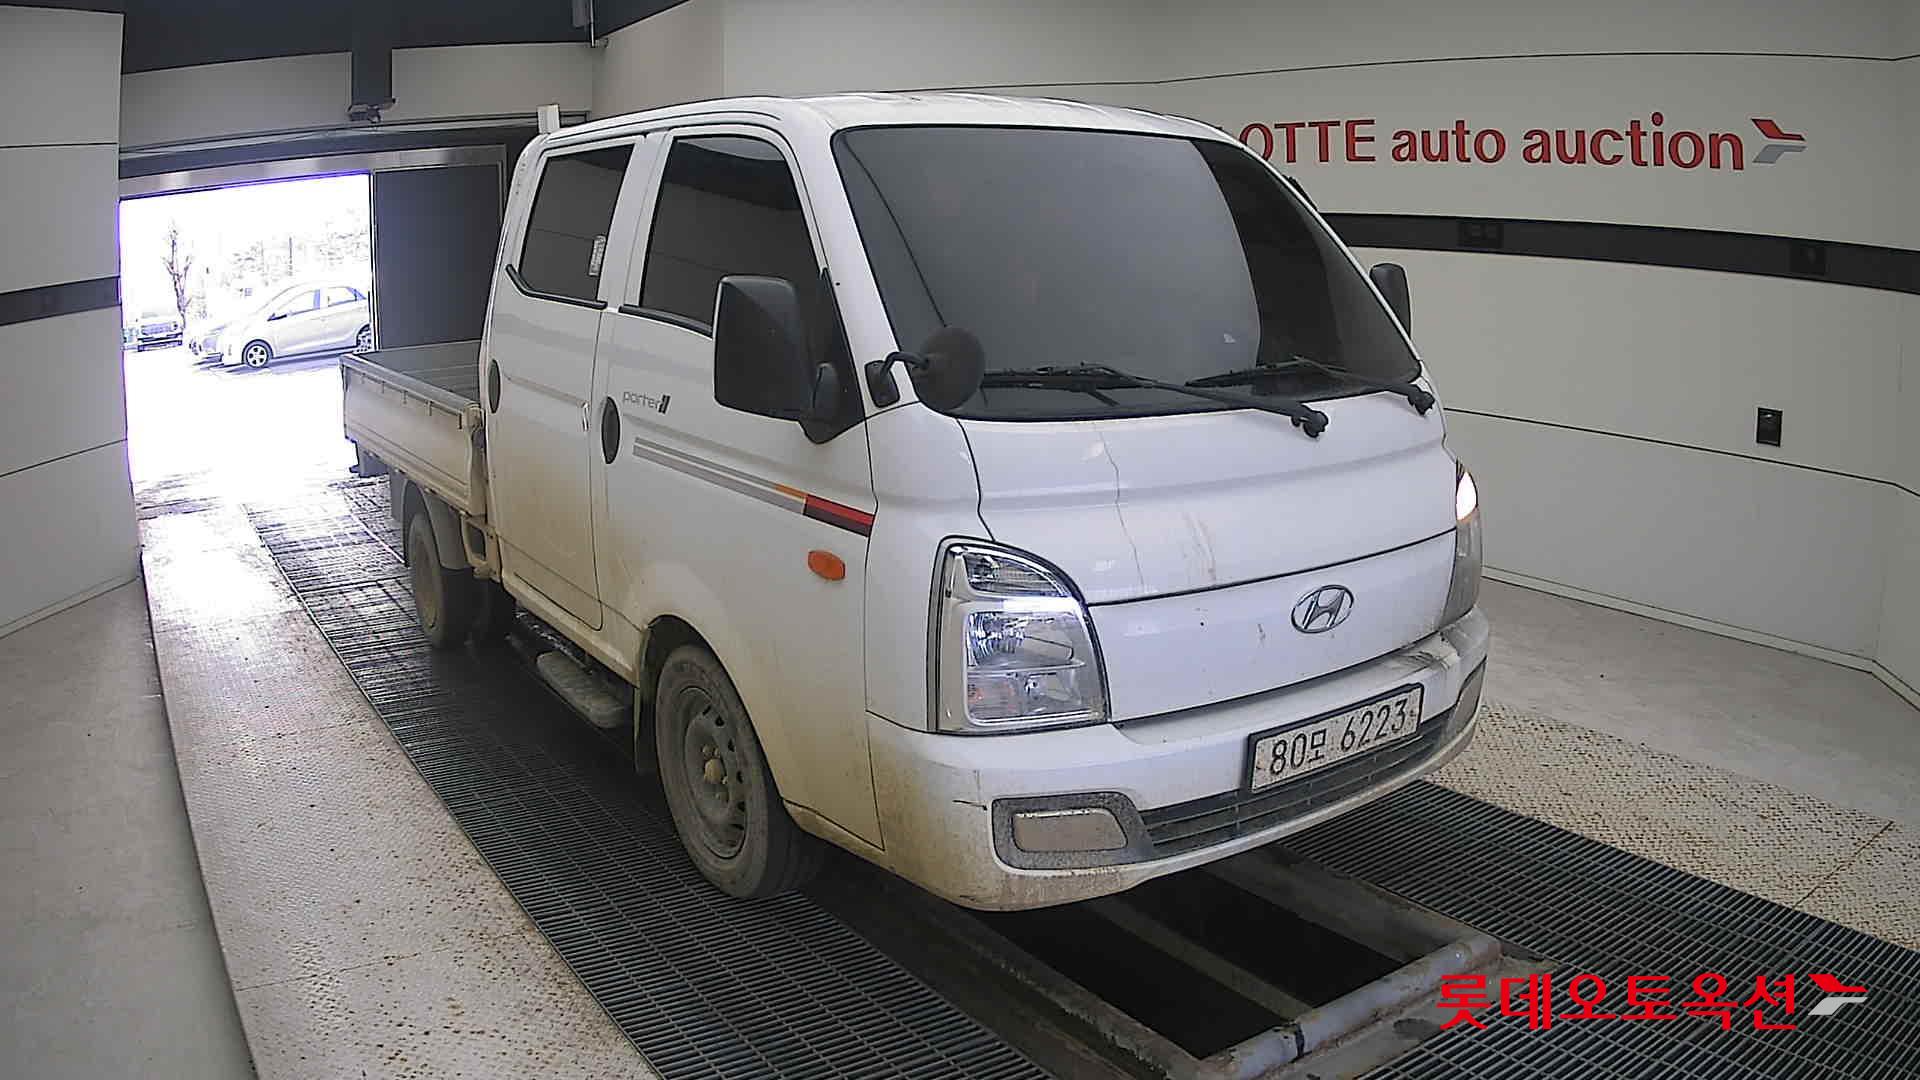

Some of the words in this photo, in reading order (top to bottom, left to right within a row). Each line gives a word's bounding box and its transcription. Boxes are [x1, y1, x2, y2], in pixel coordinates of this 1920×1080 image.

[1216, 118, 1376, 163] OTTE
[1391, 120, 1506, 164] auto
[1522, 112, 1744, 170] auction
[1270, 728, 1327, 775] 80모
[1340, 698, 1408, 751] 6223
